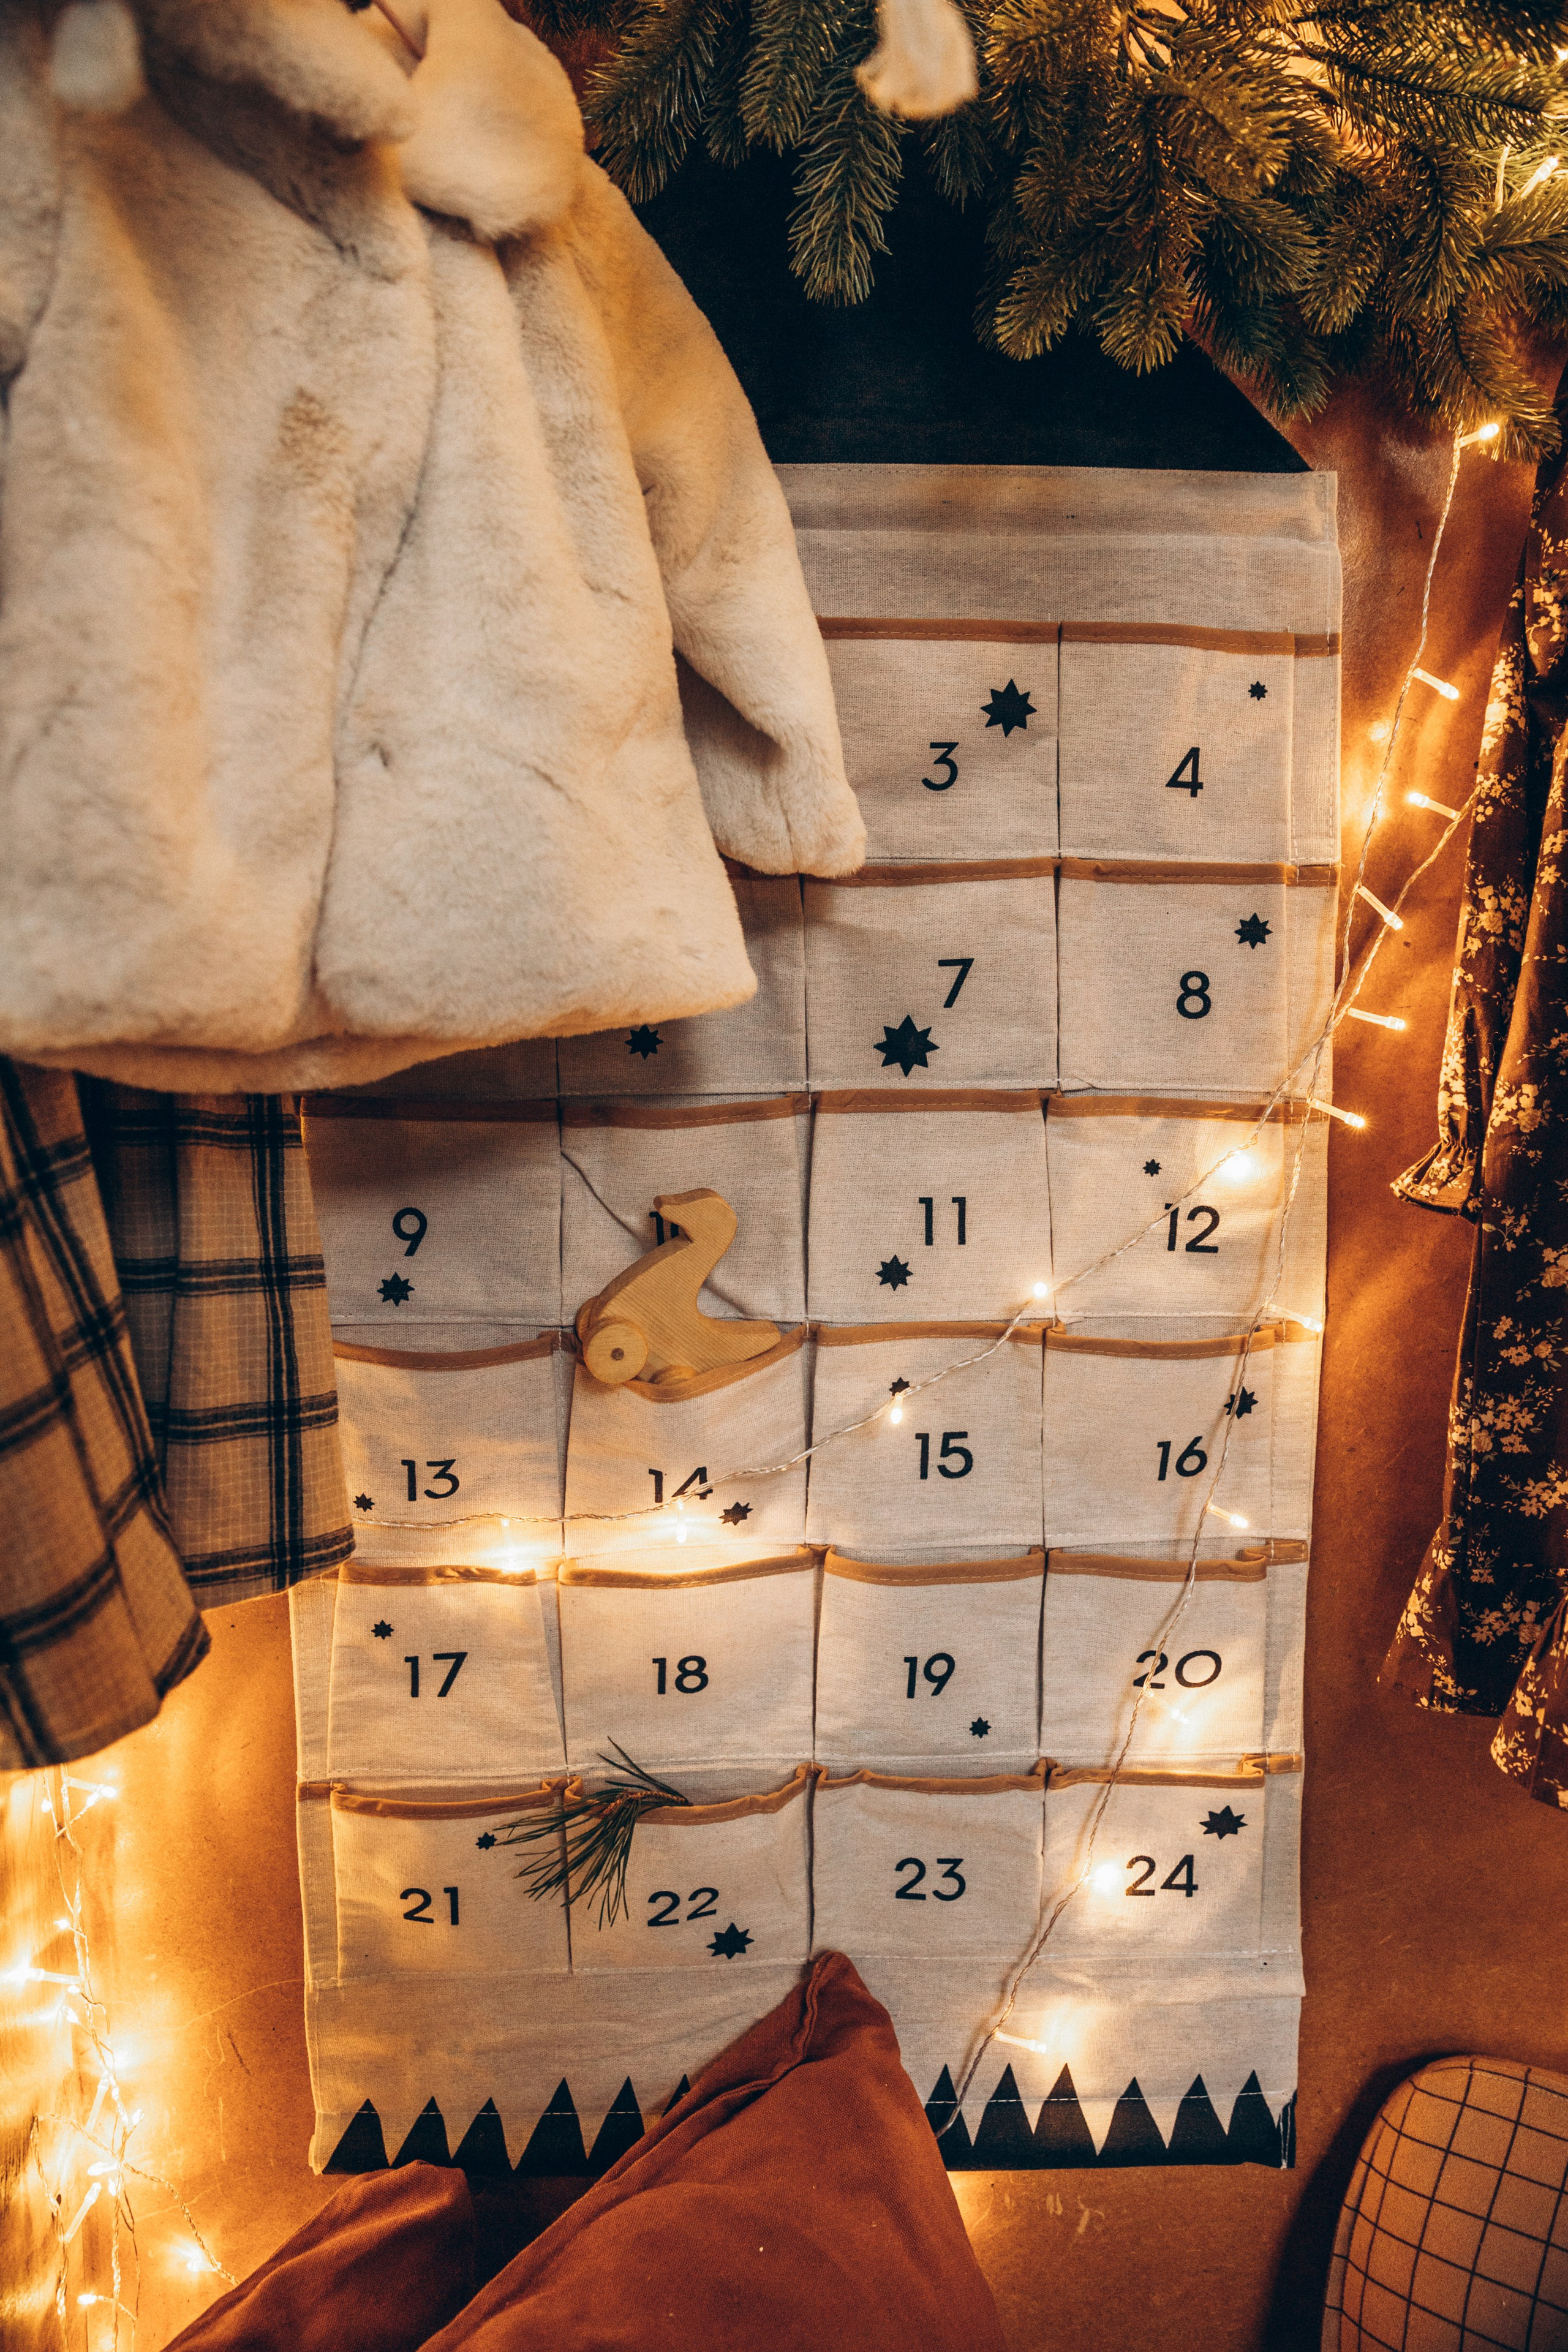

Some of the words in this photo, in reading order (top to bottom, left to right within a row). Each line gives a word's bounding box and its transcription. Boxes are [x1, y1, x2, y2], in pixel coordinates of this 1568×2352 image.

[921, 742, 959, 791] 3
[1166, 747, 1204, 798] 4
[938, 957, 975, 1009] 7
[1176, 970, 1212, 1020] 8
[393, 1207, 428, 1257] 9
[649, 1211, 679, 1247] 1
[919, 1197, 967, 1246] 11
[1164, 1203, 1220, 1254] 12
[915, 1431, 974, 1480] 15
[1157, 1436, 1208, 1482] 16
[401, 1458, 460, 1502] 13
[648, 1466, 714, 1503] 14
[404, 1652, 469, 1698] 17
[652, 1655, 709, 1695] 18
[904, 1653, 956, 1699] 19
[1133, 1650, 1222, 1689] 20
[895, 1858, 966, 1902] 23
[1126, 1854, 1199, 1898] 24
[400, 1887, 459, 1926] 21
[647, 1887, 719, 1927] 22
